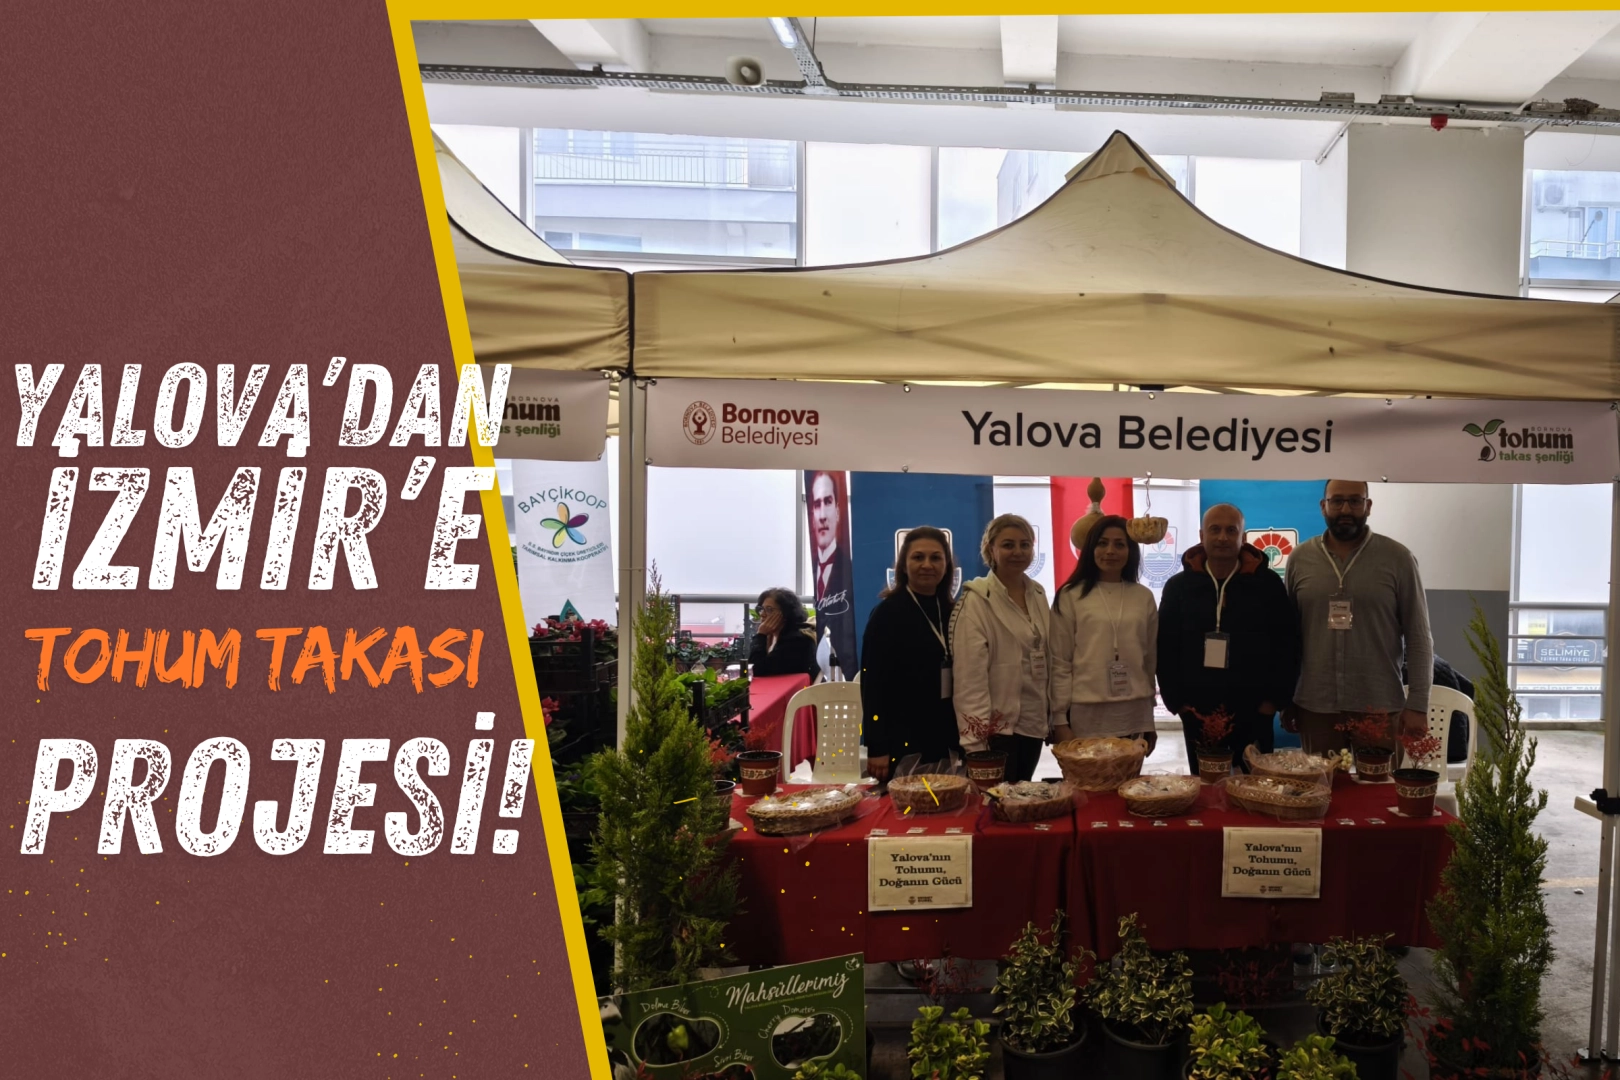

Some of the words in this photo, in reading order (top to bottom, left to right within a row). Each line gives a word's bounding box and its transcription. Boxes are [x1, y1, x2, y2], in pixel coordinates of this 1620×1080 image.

[502, 398, 560, 421] hum
[722, 402, 819, 426] Bornova
[515, 422, 561, 438] şenliği
[722, 425, 818, 449] Belediyesi
[961, 410, 1101, 449] Yalova
[1118, 415, 1334, 461] Belediyesi
[1498, 427, 1574, 449] tohum
[1499, 450, 1532, 461] takas
[1535, 451, 1574, 464] şenliği
[517, 485, 607, 514] BAYÇİKOOP
[521, 544, 547, 559] TARIMSAL
[1540, 647, 1591, 657] SELİMİYE
[895, 865, 947, 875] Tohumu,
[1233, 866, 1280, 877] Doğanın
[1283, 868, 1311, 876] Gücü
[879, 878, 929, 888] Doğanın
[932, 876, 962, 886] Gücü
[726, 972, 850, 1014] Mahsüllerimiz
[758, 1014, 781, 1039] Cherry
[782, 1004, 816, 1015] Domates
